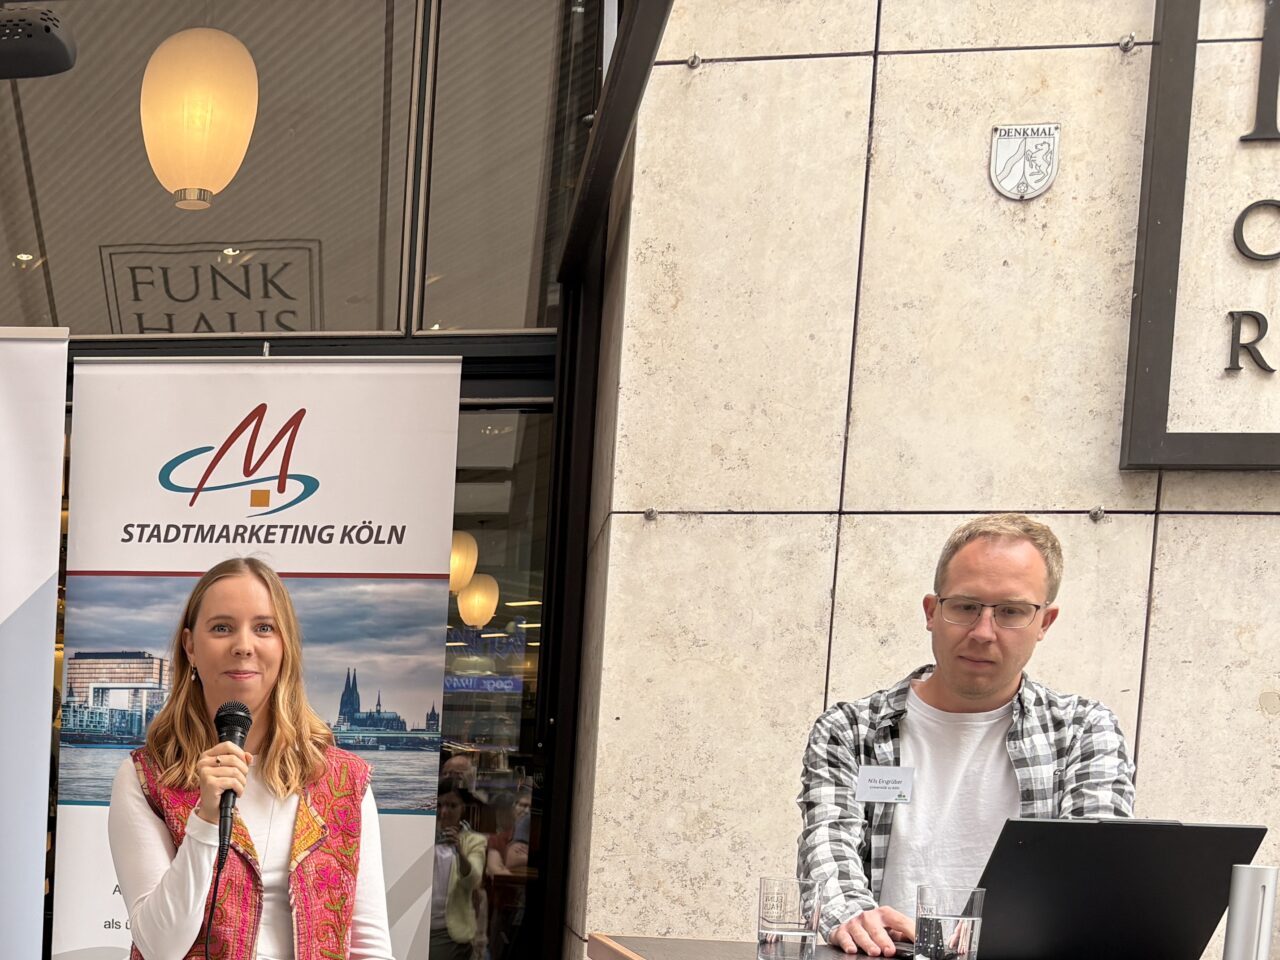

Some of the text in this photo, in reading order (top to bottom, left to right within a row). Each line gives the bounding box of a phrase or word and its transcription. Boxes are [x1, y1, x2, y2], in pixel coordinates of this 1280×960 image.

[999, 127, 1055, 137] DENKMAL
[127, 262, 297, 302] FUNK
[120, 520, 407, 544] STADTMARKETING KÖLN
[103, 918, 122, 930] als
